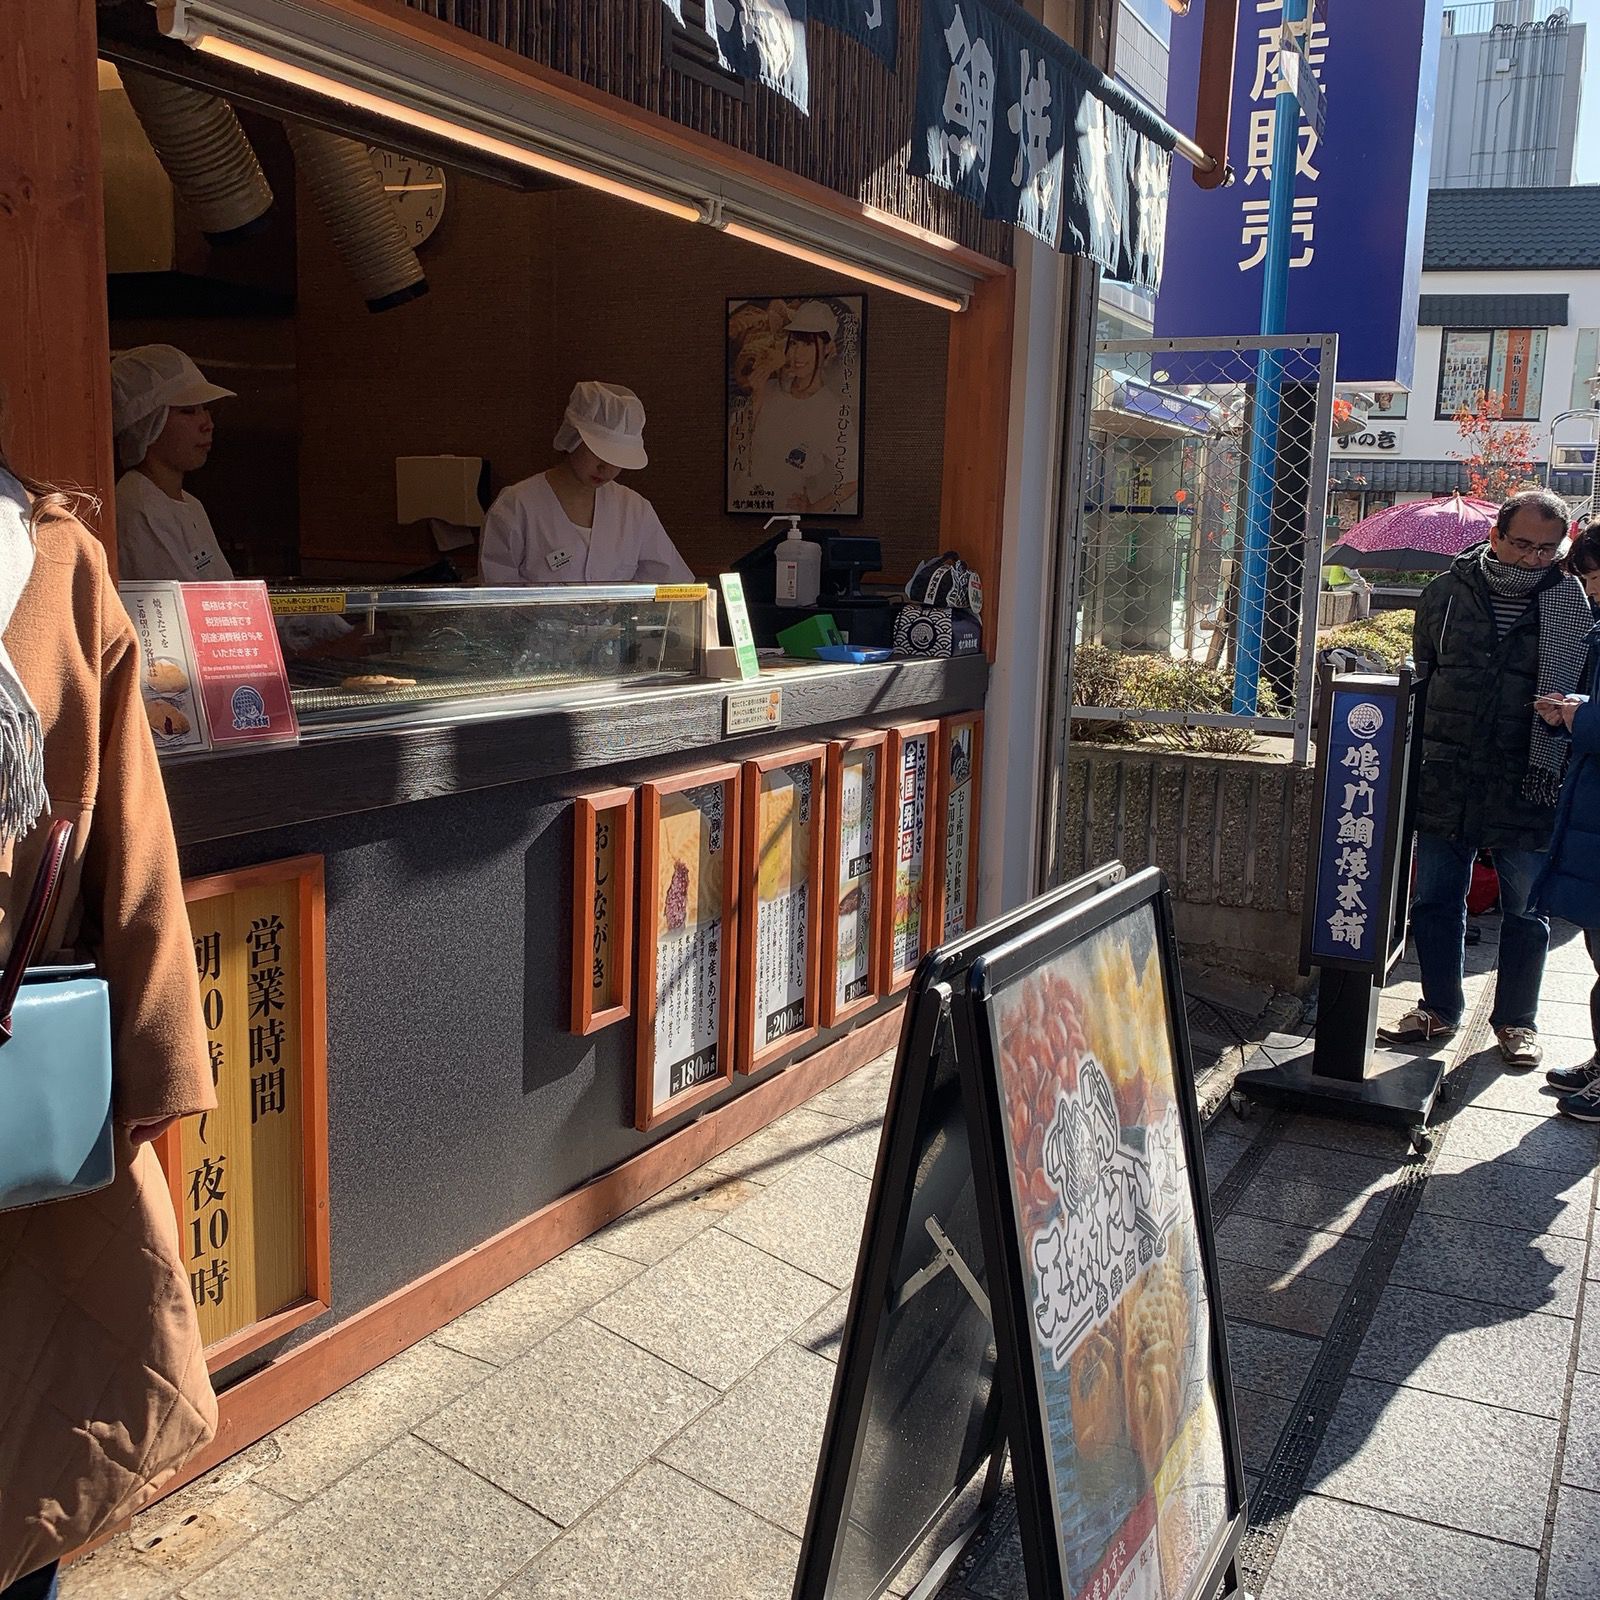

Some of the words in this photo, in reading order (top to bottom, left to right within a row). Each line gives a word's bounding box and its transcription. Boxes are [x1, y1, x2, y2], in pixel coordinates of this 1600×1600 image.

[1238, 0, 1330, 272] 産販売
[201, 600, 249, 612] 価格はすべて
[205, 616, 252, 628] 税別価格です
[212, 647, 259, 659] いただきます
[901, 740, 918, 863] 全国発送
[1326, 742, 1381, 950] 鳴門鯛焼本舗
[593, 821, 610, 990] おしながき
[245, 914, 287, 1125] 営業時間
[706, 919, 719, 1036] 十勝産あずき
